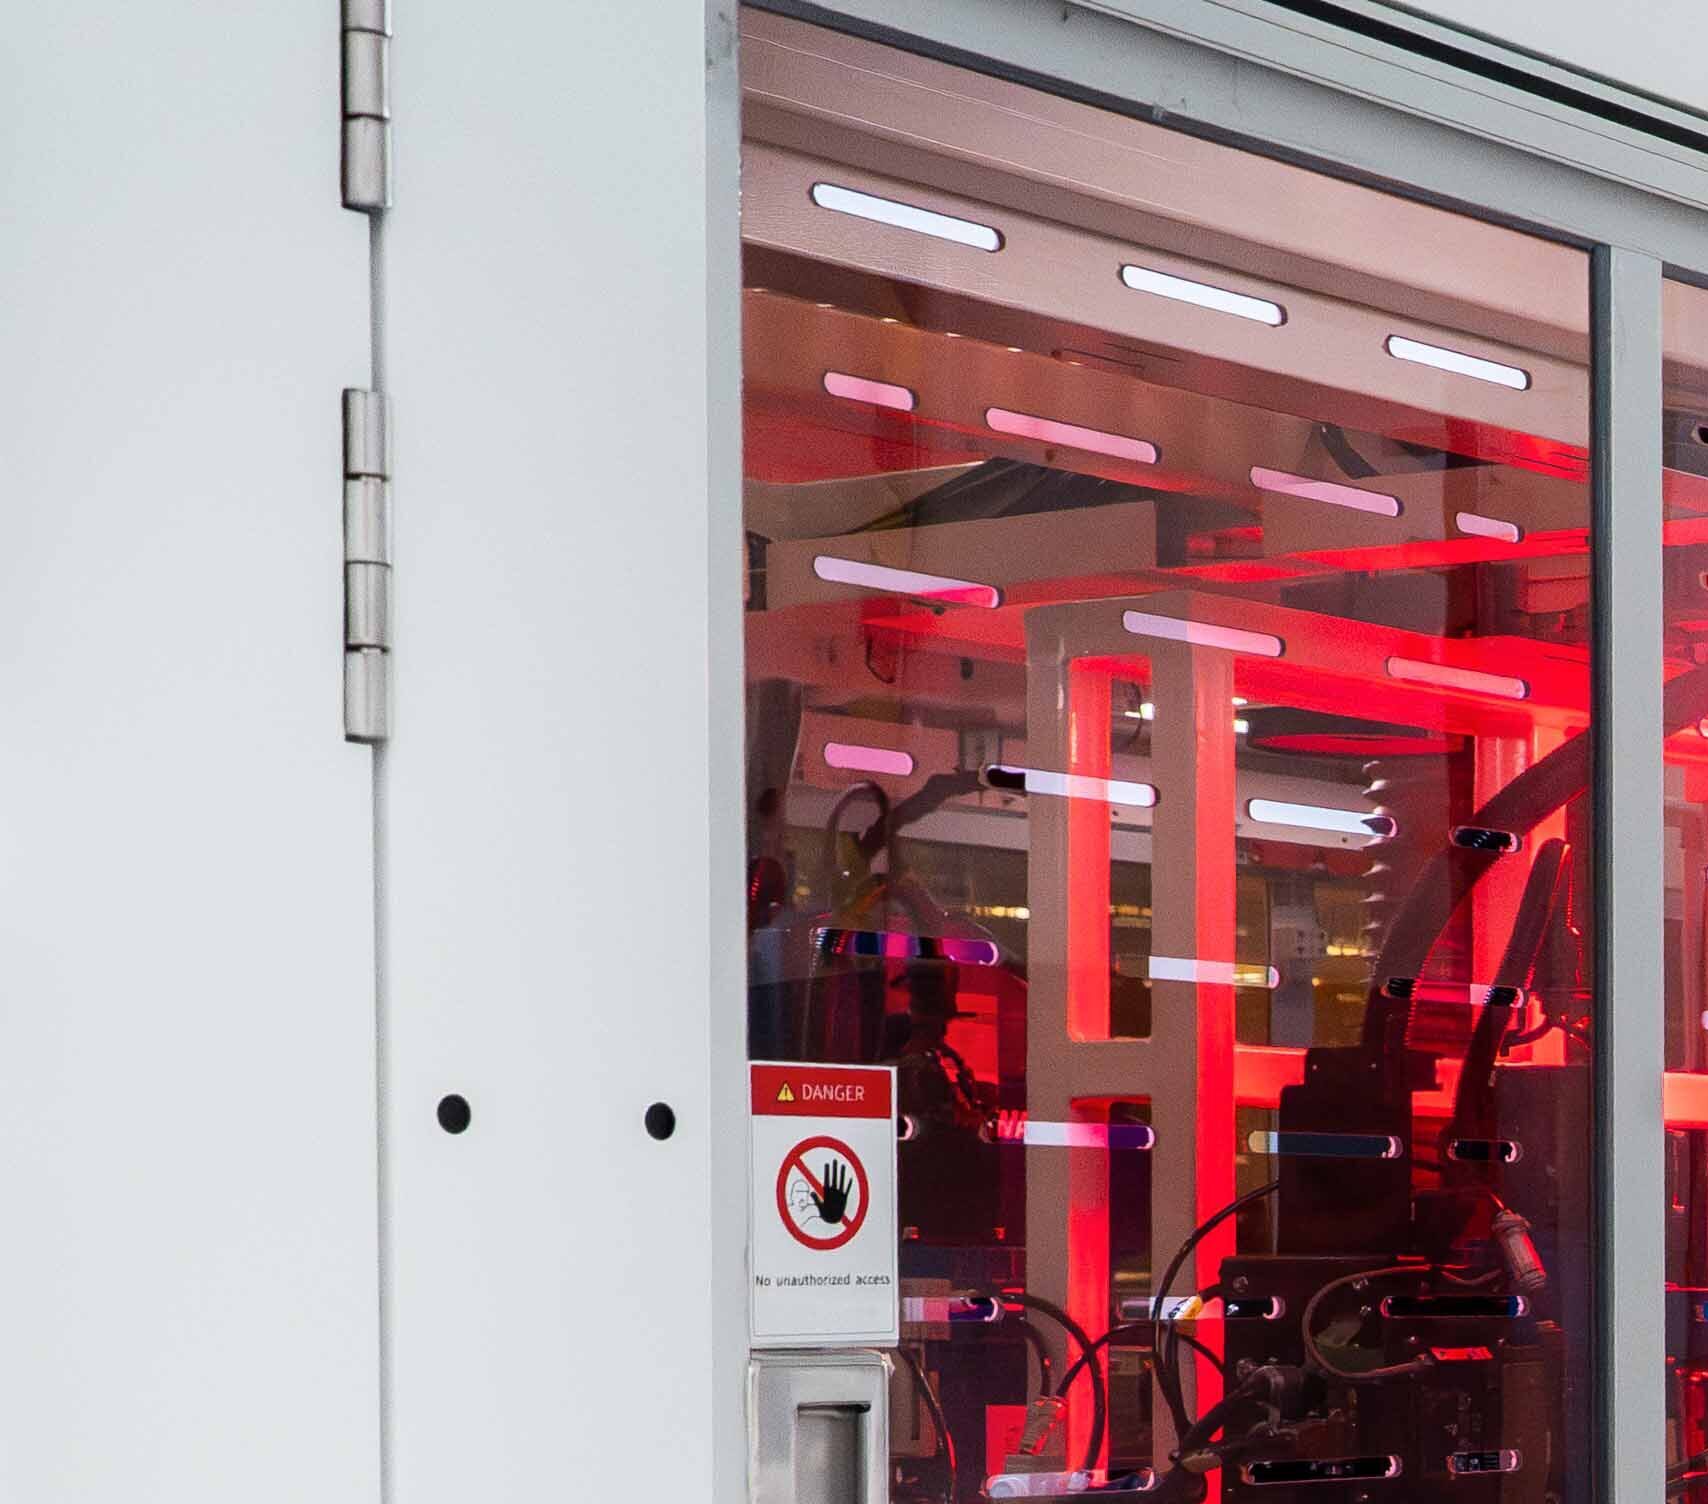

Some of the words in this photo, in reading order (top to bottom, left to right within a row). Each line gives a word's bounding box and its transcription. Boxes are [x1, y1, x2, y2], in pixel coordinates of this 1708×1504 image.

[802, 1083, 865, 1102] DANGER
[755, 1275, 771, 1287] No
[776, 1274, 851, 1287] unauthorized
[856, 1275, 891, 1286] access
